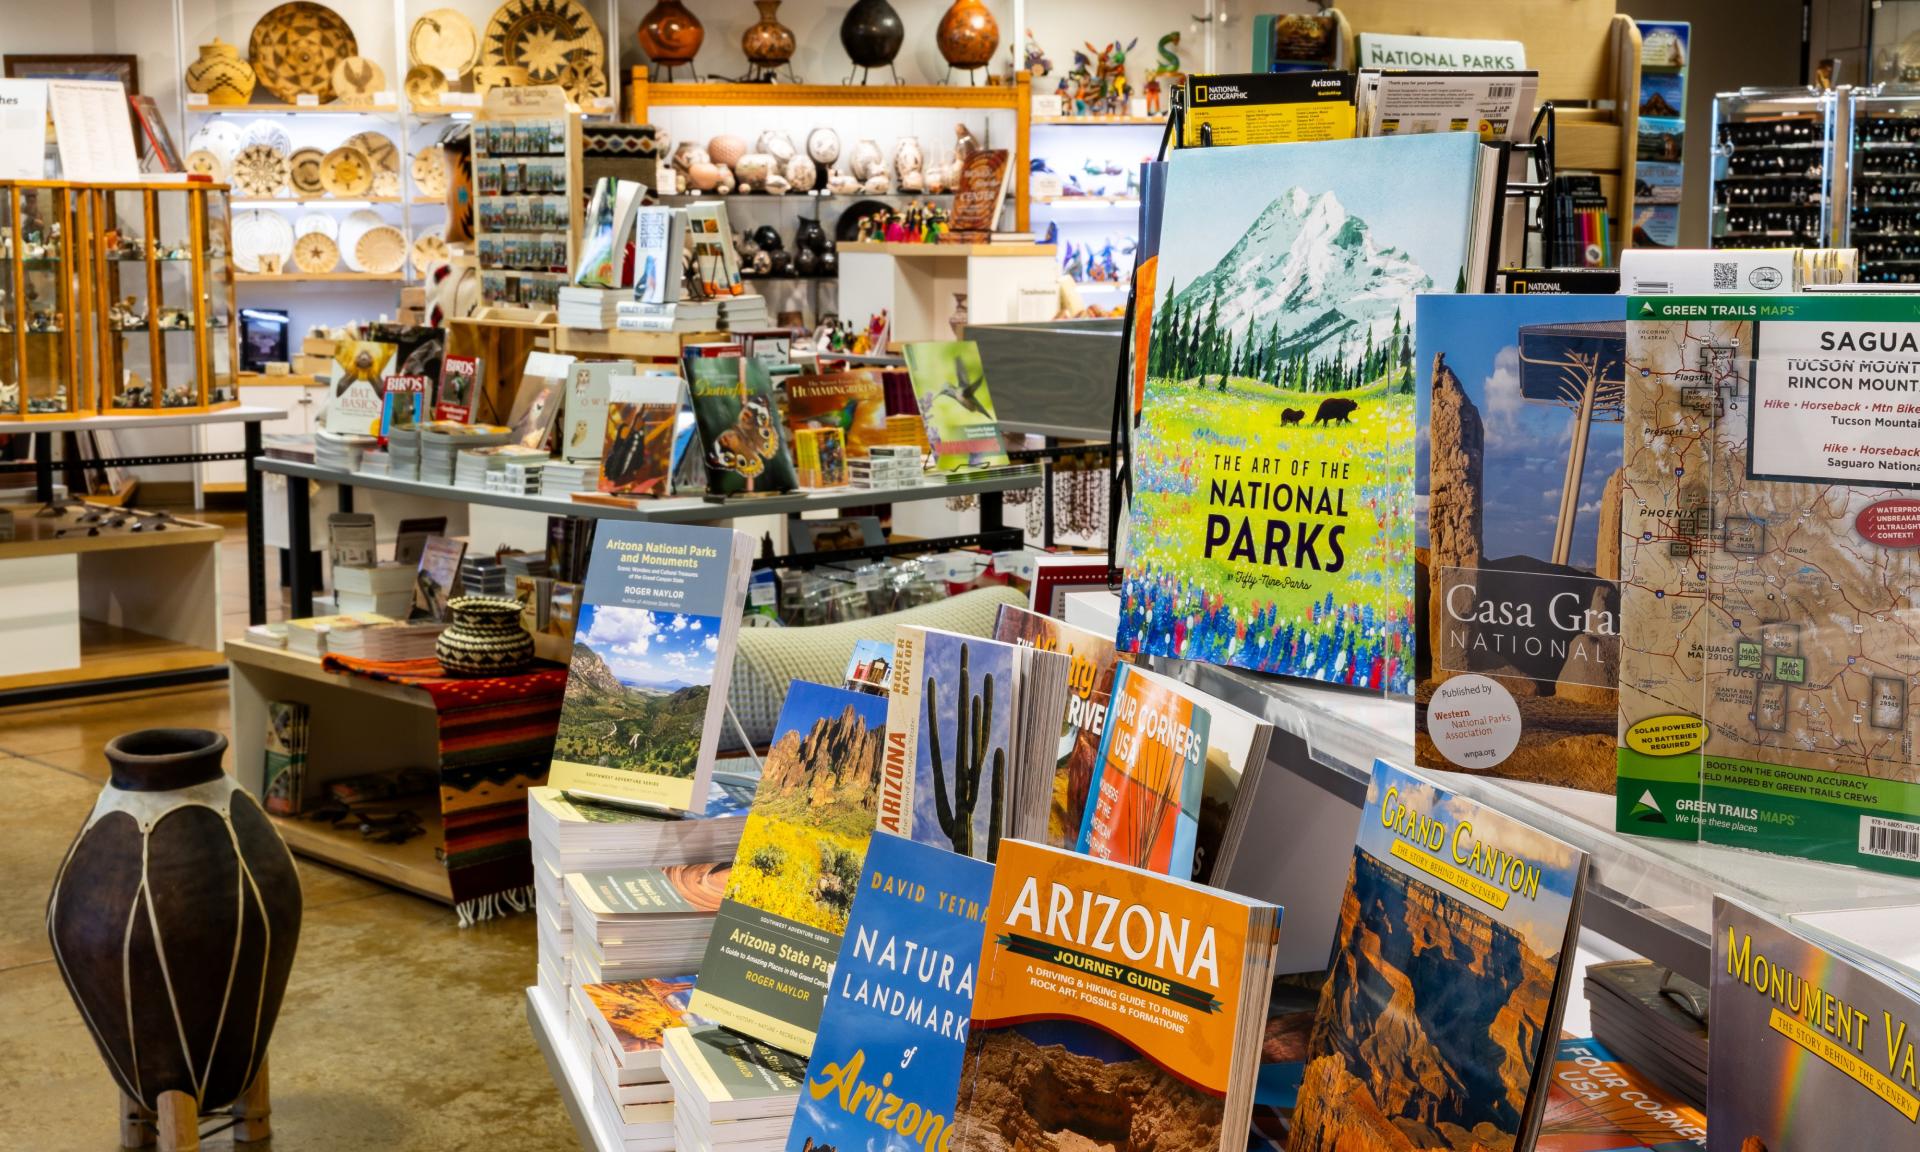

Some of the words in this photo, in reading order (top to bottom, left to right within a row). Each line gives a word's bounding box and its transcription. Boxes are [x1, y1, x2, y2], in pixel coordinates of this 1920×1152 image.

[1372, 50, 1458, 68] NATIONAL
[1463, 54, 1515, 70] PARKS
[1209, 85, 1239, 94] NATIONAL
[1311, 79, 1341, 88] Arizona
[1209, 92, 1248, 101] GEOGRAPHIC
[1528, 282, 1562, 291] NATIONAL
[1662, 305, 1707, 316] GREEN
[1711, 305, 1757, 315] TRAILS
[1760, 305, 1794, 315] MAPS
[1820, 331, 1919, 353] SAGUA
[446, 358, 474, 376] BIRDS
[1787, 358, 1852, 373] TUCSON
[1859, 361, 1920, 374] MOUNT
[386, 376, 423, 391] BIRDS
[1788, 376, 1852, 390] RINCON
[1858, 379, 1920, 392] MOUNT
[1763, 399, 1790, 409] Hike
[1801, 400, 1860, 412] Horseback
[1871, 403, 1893, 414] Mtn
[1896, 404, 1920, 414] Bike
[1645, 428, 1683, 436] Prescott
[1831, 416, 1871, 426] Tucson
[1822, 443, 1848, 454] Hike
[1859, 445, 1920, 457] Horseback
[1214, 455, 1242, 471] THE
[1251, 457, 1281, 474] ART
[1291, 459, 1310, 477] OF
[1321, 462, 1350, 480] THE
[1827, 457, 1875, 469] Saguaro
[1209, 478, 1348, 517] NATIONAL
[1640, 509, 1697, 518] PHOENIX
[606, 539, 643, 552] Arizona
[645, 542, 687, 555] National
[689, 545, 717, 558] Parks
[1203, 513, 1346, 573] PARKS
[620, 553, 638, 563] and
[641, 554, 698, 569] Monuments
[624, 586, 652, 596] ROGER
[653, 588, 684, 599] NAYLOR
[1281, 577, 1312, 590] Parks
[1446, 583, 1535, 628] Casa
[1548, 592, 1621, 636] Gra
[1450, 630, 1605, 664] NATIONAL
[893, 638, 905, 694] ROGER
[901, 640, 913, 696] NAYLOR
[1726, 668, 1772, 681] TUCSON
[1442, 683, 1481, 699] Published
[1481, 684, 1492, 695] by
[1067, 694, 1109, 735] RIVE
[1434, 708, 1470, 721] Western
[1451, 716, 1487, 729] National
[1488, 713, 1512, 725] Parks
[1138, 704, 1202, 765] CORNERS
[1445, 726, 1493, 740] Association
[1634, 726, 1661, 735] SOLAR
[1662, 722, 1702, 732] POWERED
[1655, 733, 1698, 743] BATTERIES
[1114, 729, 1141, 768] USA
[1463, 748, 1496, 759] wnpa.org
[1650, 741, 1691, 751] REQUIRED
[881, 732, 907, 833] ARIZONA
[1706, 760, 1738, 772] BOOTS
[1739, 764, 1753, 774] ON
[1756, 766, 1772, 777] THE
[1774, 769, 1814, 783] GROUND
[1816, 776, 1868, 791] ACCURACY
[1698, 771, 1724, 783] FELD
[1725, 775, 1760, 788] MAPPED
[1762, 779, 1774, 789] BY
[1776, 782, 1807, 794] GREEN
[1810, 787, 1841, 799] TRAILS
[1844, 792, 1878, 804] CREWS
[1675, 799, 1716, 814] GREEN
[1718, 803, 1758, 820] TRAILS
[1760, 811, 1795, 826] MAPS
[1675, 813, 1689, 823] We
[1691, 815, 1707, 825] loe
[1709, 816, 1731, 828] these
[1731, 820, 1758, 834] places
[1381, 786, 1446, 852] GRAND
[1451, 820, 1541, 901] CANYON
[1396, 844, 1408, 857] THE
[1410, 852, 1429, 867] STORY
[1430, 861, 1455, 880] BEHIND
[1456, 874, 1470, 889] THE
[871, 871, 925, 903] DAVID
[760, 916, 788, 930] SOUTHWEST
[787, 925, 814, 940] ADVENTURE
[814, 933, 830, 944] SERIES
[1004, 876, 1220, 988] ARIZONA
[729, 927, 777, 955] Arizona
[778, 943, 810, 967] State
[720, 945, 725, 953] A
[725, 947, 740, 957] Guide
[740, 952, 746, 960] to
[746, 954, 768, 968] Amazing
[768, 961, 784, 973] Places
[790, 969, 798, 978] the
[798, 972, 814, 983] Grand
[852, 924, 974, 1000] NATURA
[1053, 950, 1124, 980] JOURNEY
[1126, 970, 1171, 996] GUIDE
[745, 970, 775, 988] ROGER
[776, 982, 810, 1001] NAYLOR
[1026, 965, 1034, 973] A
[1035, 966, 1076, 986] DRIVING
[1076, 978, 1084, 988] &
[1085, 981, 1117, 999] HIKING
[1119, 991, 1147, 1009] GUIDE
[1148, 1001, 1161, 1013] TO
[1161, 1006, 1191, 1025] RUINS,
[842, 973, 969, 1044] LANDMARK
[1030, 977, 1057, 992] ROCK
[1058, 985, 1078, 1000] ART,
[1080, 991, 1117, 1012] FOSSILS
[1119, 1003, 1127, 1014] &
[1128, 1007, 1185, 1034] FORMATIONS
[1726, 924, 1870, 1053] MONUMENT
[1883, 1009, 1920, 1090] VA
[900, 1046, 917, 1069] of
[1562, 1047, 1630, 1089] FOUR
[1778, 1017, 1793, 1033] THE
[1796, 1027, 1822, 1050] STORY
[1824, 1045, 1856, 1073] BEHIND
[1858, 1066, 1875, 1085] THE
[1876, 1079, 1913, 1112] SCENERY
[1558, 1071, 1610, 1101] USA
